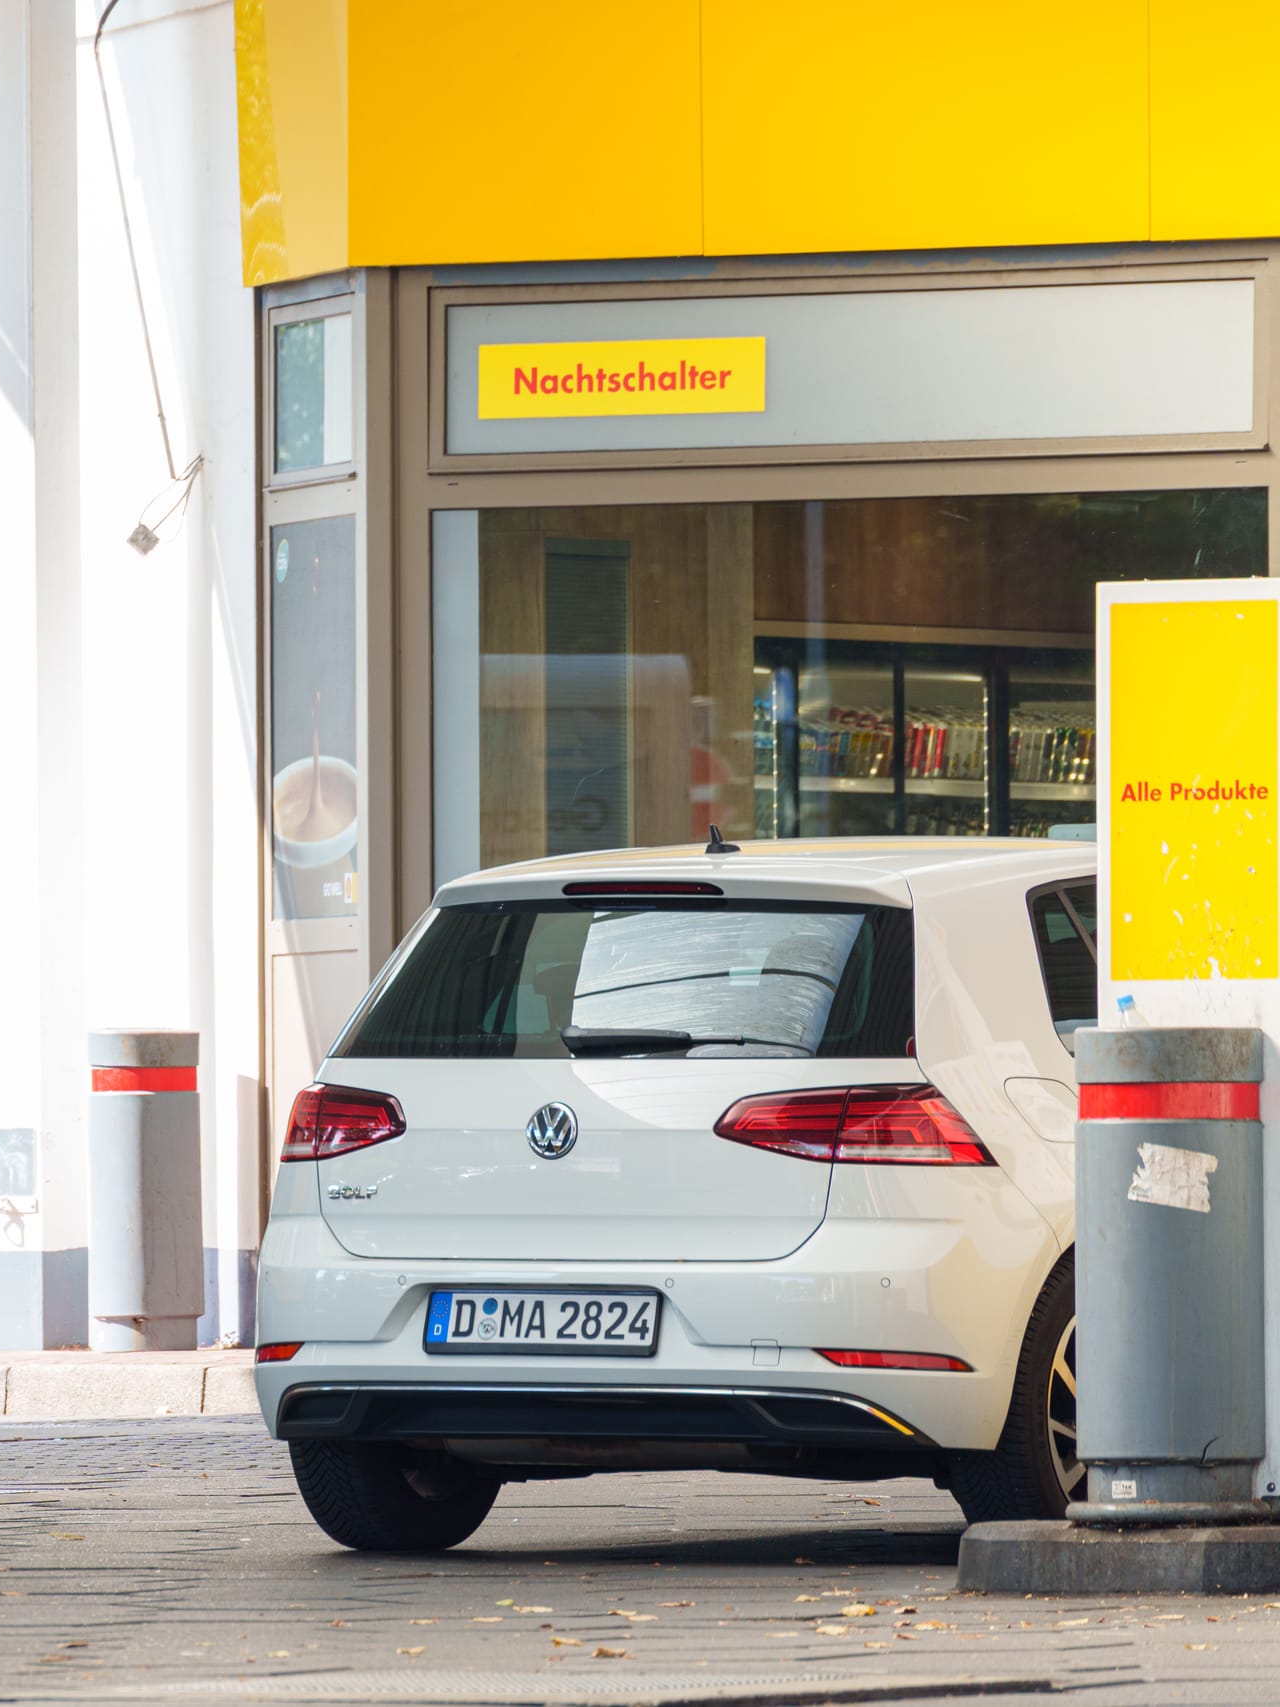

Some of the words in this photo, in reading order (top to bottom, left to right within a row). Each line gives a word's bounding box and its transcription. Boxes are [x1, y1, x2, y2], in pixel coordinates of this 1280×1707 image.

[513, 360, 732, 396] Nachtschalter
[1121, 781, 1162, 802] Alle
[1170, 779, 1269, 801] Produkte
[327, 1184, 378, 1199] GOLF
[433, 1323, 442, 1336] D
[452, 1299, 477, 1338] D
[499, 1300, 546, 1339] MA
[556, 1300, 651, 1341] 2824
